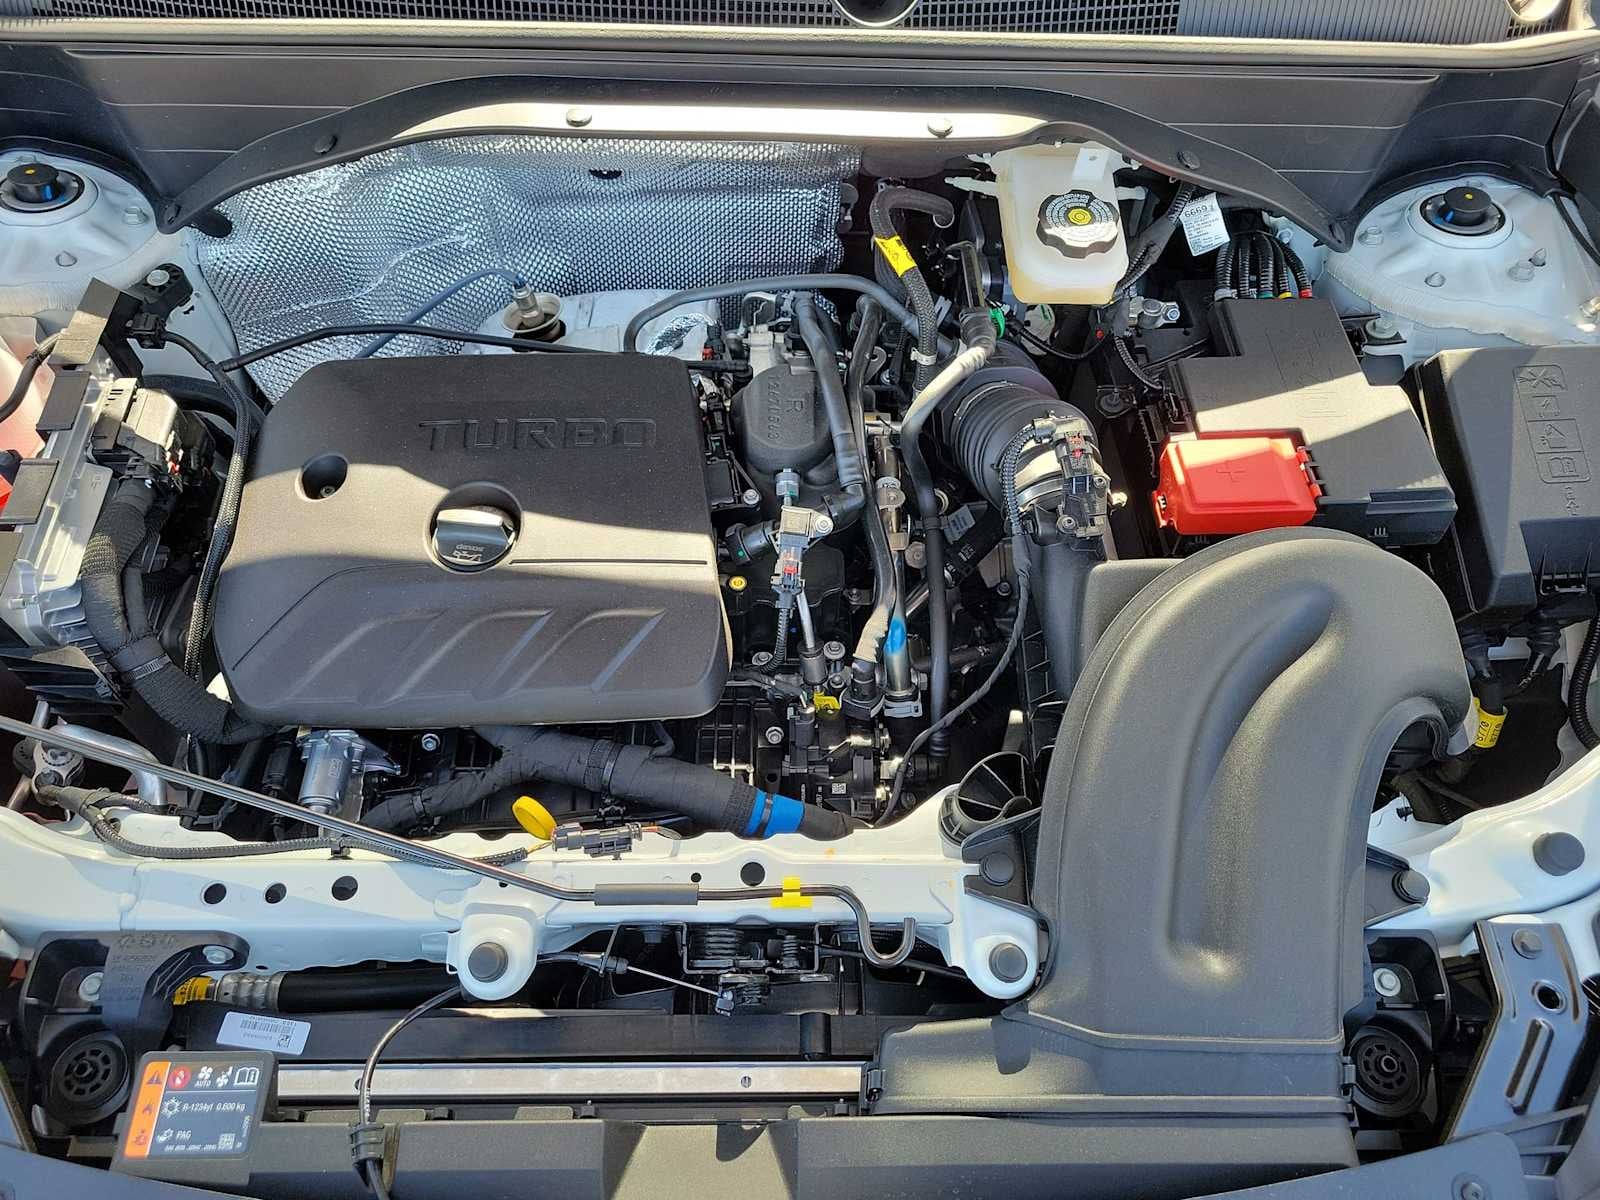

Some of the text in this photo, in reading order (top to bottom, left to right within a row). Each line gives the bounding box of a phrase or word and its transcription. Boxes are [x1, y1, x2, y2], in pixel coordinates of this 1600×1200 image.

[418, 417, 657, 451] TURBO
[236, 1102, 246, 1112] kg
[175, 1130, 192, 1140] PAG
